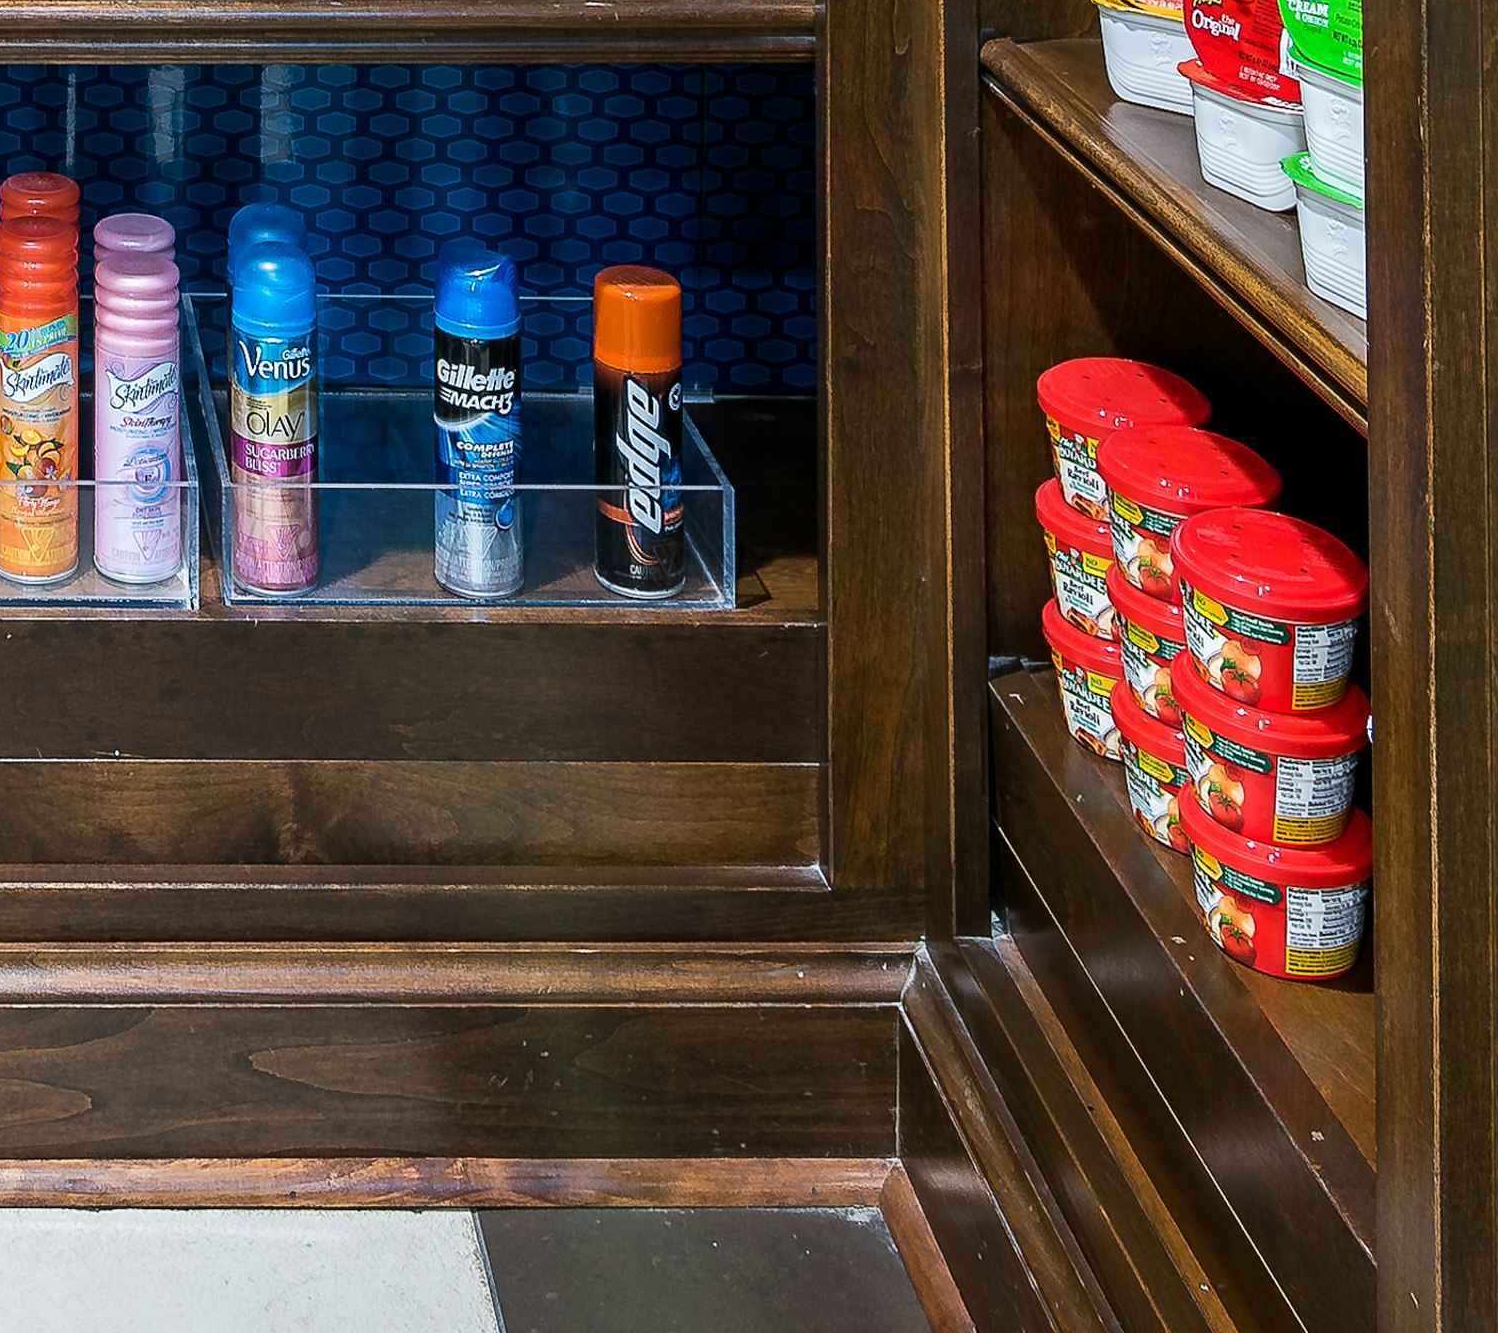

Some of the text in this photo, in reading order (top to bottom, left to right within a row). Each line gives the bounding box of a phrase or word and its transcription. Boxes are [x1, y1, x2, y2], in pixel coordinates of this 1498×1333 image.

[1221, 14, 1236, 25] the
[1288, 0, 1329, 17] CREAM
[1191, 9, 1241, 41] Original
[239, 340, 310, 379] Venus
[4, 357, 71, 396] Skintimate
[437, 359, 515, 391] Gillette
[111, 368, 177, 409] Skintimate
[449, 391, 514, 414] MACH3
[246, 411, 304, 441] OLAY
[456, 440, 514, 453] COMPLETE
[616, 379, 672, 534] edge
[245, 458, 277, 473] BLISS
[459, 471, 481, 481] EXTRA
[1063, 583, 1093, 606] Ravioli
[1069, 700, 1100, 726] Ravioli
